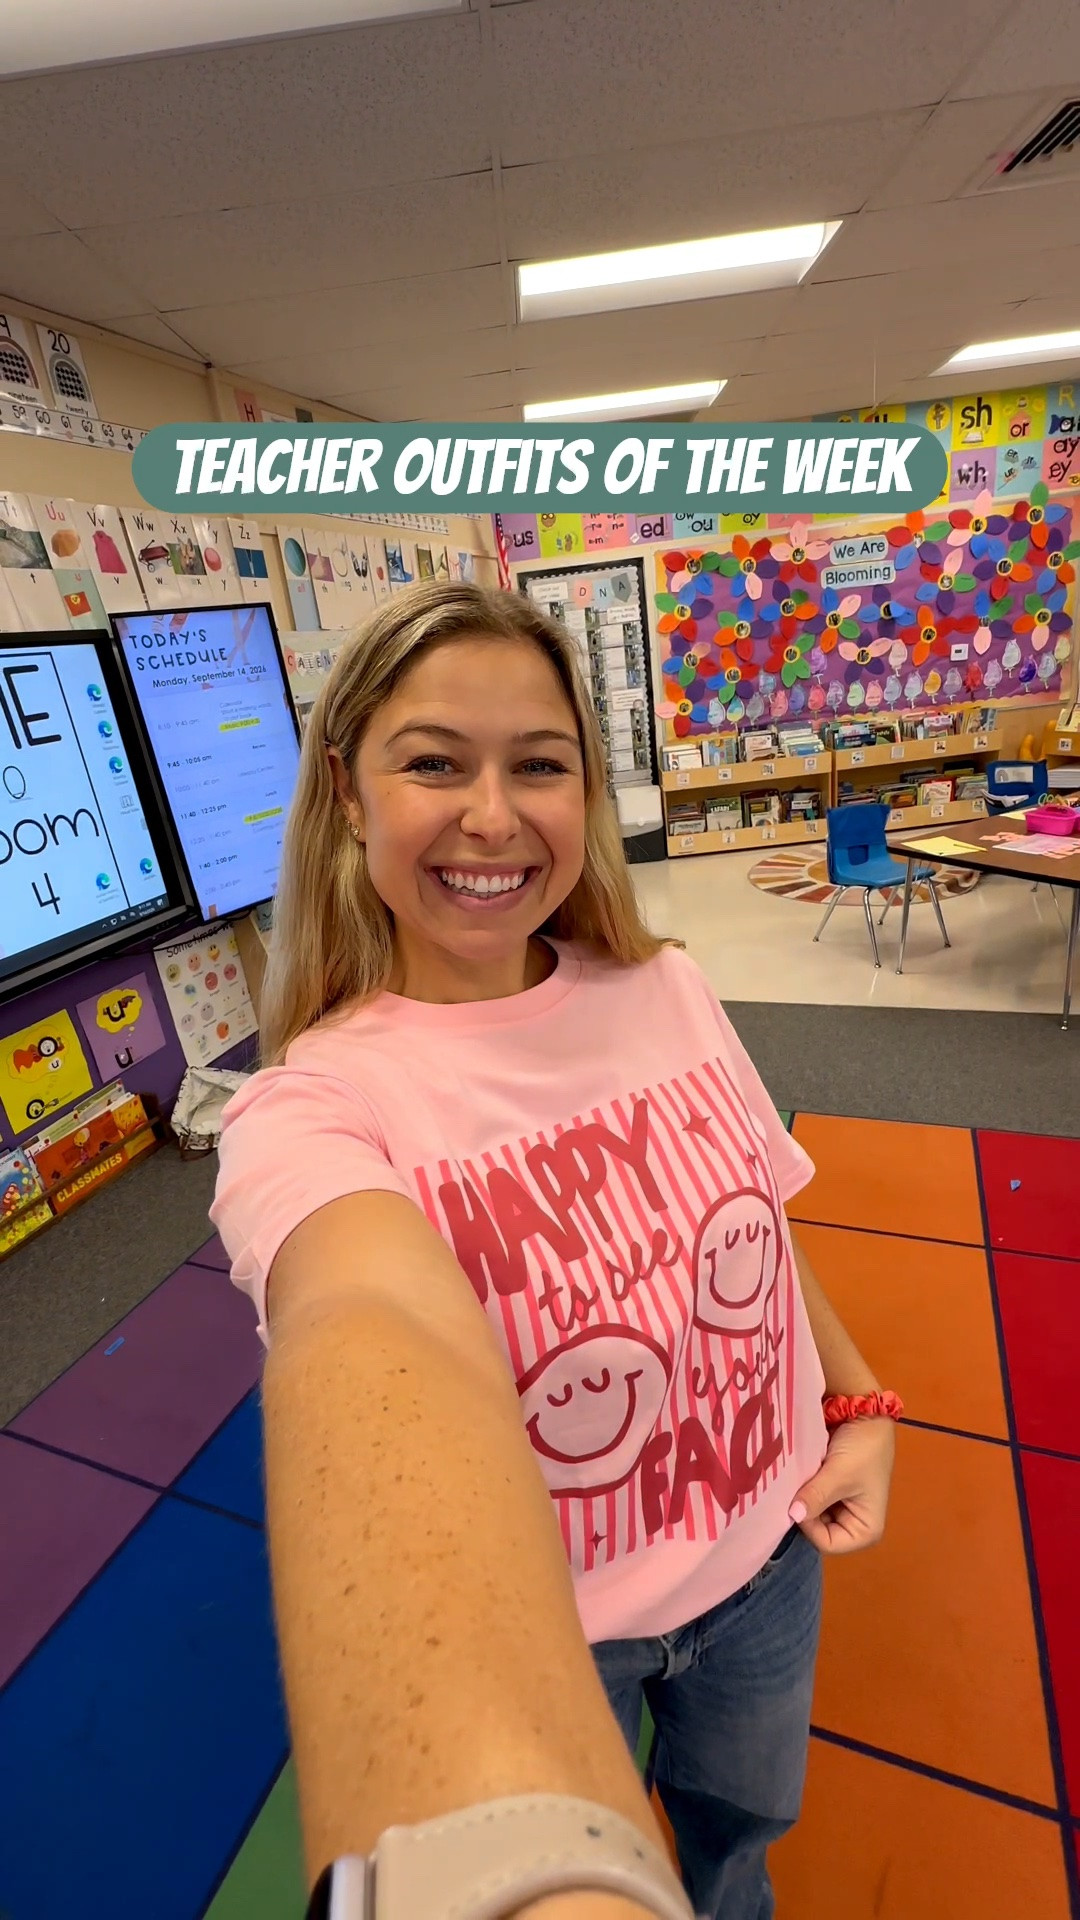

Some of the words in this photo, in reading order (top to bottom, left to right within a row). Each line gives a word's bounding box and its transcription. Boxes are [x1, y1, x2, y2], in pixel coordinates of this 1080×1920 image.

[48, 329, 71, 354] 20
[66, 404, 89, 418] twenty
[961, 397, 993, 430] sh
[35, 410, 51, 425] 60
[60, 415, 73, 430] 61
[81, 419, 94, 434] 62
[101, 424, 115, 438] 63
[121, 428, 134, 441] 64
[1010, 421, 1030, 438] or
[957, 460, 987, 486] wh
[1048, 460, 1072, 482] ey
[132, 514, 154, 531] Ww
[640, 516, 665, 539] ed
[513, 530, 534, 548] us
[833, 544, 855, 559] We
[860, 541, 886, 555] Are
[826, 565, 891, 585] Blooming
[129, 629, 207, 650] TODAY'S
[136, 648, 228, 671] SCHEDULE
[192, 669, 235, 684] September
[249, 665, 267, 675] 2026
[31, 872, 61, 915] 4
[56, 1152, 123, 1203] CLASSMATES
[438, 1098, 668, 1305] HAPPY
[538, 1269, 601, 1332] to
[611, 1227, 683, 1302] see
[691, 1325, 785, 1437] your
[640, 1360, 784, 1536] FACE
